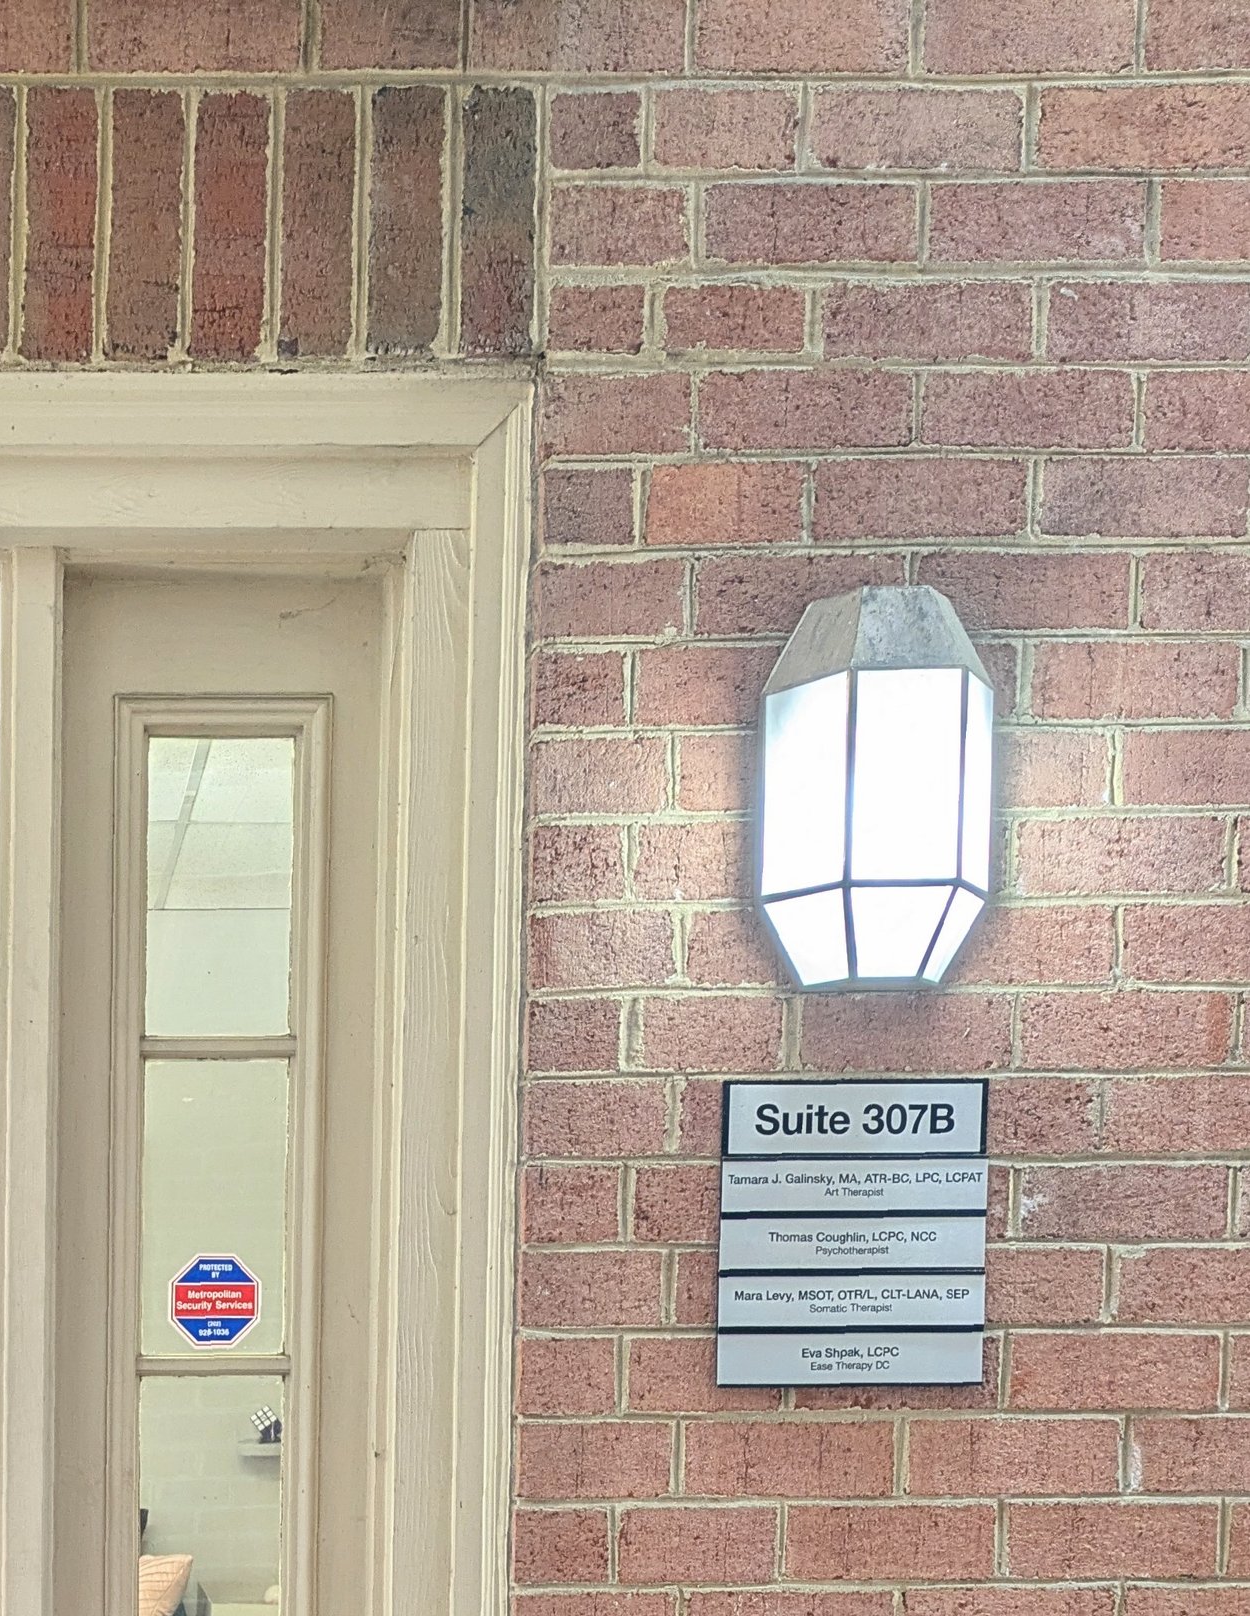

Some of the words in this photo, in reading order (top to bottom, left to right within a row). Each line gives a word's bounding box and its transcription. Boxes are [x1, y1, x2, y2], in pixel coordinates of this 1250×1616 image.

[754, 1103, 850, 1135] Suite
[862, 1102, 956, 1135] 307B
[728, 1174, 769, 1185] Tamara
[771, 1173, 782, 1184] J.
[785, 1173, 836, 1186] Galinsky,
[838, 1173, 861, 1185] MA,
[864, 1173, 912, 1184] ATR-BC,
[915, 1172, 942, 1184] LPC,
[945, 1172, 983, 1183] LCPAT
[824, 1187, 839, 1197] Art
[841, 1187, 884, 1198] Therapist
[768, 1231, 813, 1243] Thomas
[815, 1231, 869, 1245] Coughlin,
[872, 1231, 907, 1243] LCPC,
[910, 1231, 937, 1242] NCC
[815, 1245, 889, 1257] Psychotherapist
[187, 1290, 242, 1300] Metropolitan
[734, 1290, 763, 1301] Mara
[766, 1290, 795, 1303] Levy,
[798, 1290, 834, 1302] MSOT,
[837, 1289, 877, 1301] OTR/L,
[881, 1288, 943, 1301] CLT-LANA,
[946, 1288, 970, 1299] SEP
[176, 1300, 213, 1311] Security
[215, 1300, 253, 1310] Services
[809, 1303, 847, 1313] Somatic
[850, 1303, 893, 1314] Therapist
[801, 1347, 822, 1358] Eva
[824, 1346, 864, 1360] Shpak,
[867, 1346, 900, 1357] LCPC
[810, 1361, 833, 1371] Ease
[835, 1361, 873, 1371] Therapy
[875, 1360, 890, 1370] DC
